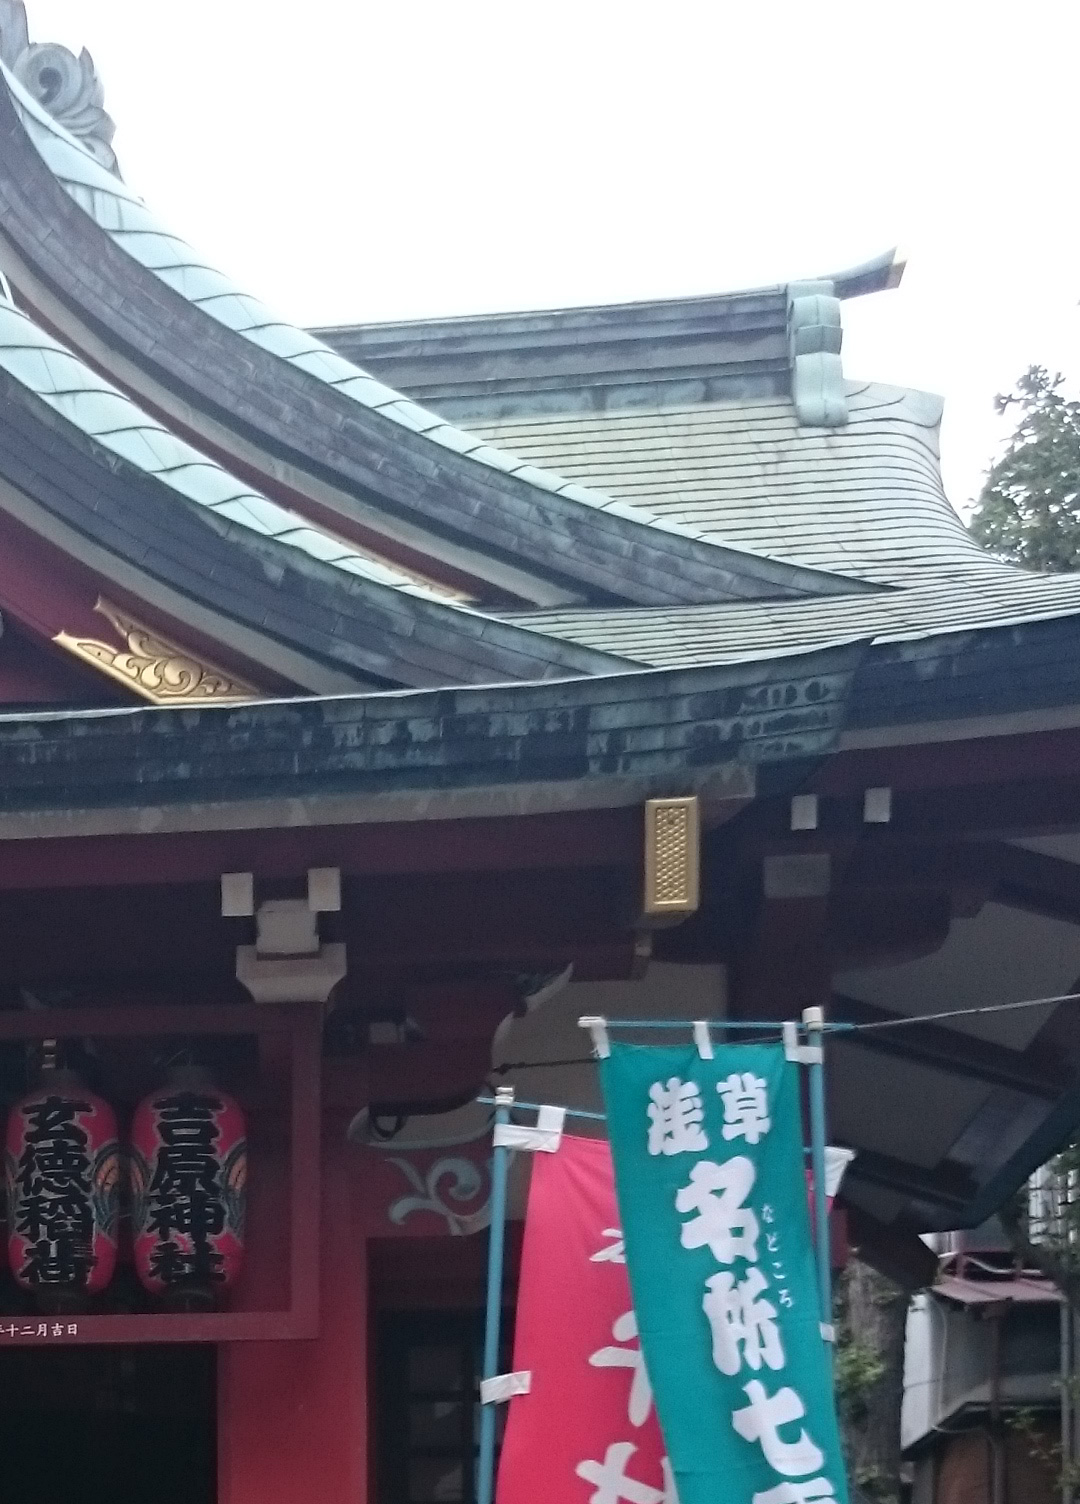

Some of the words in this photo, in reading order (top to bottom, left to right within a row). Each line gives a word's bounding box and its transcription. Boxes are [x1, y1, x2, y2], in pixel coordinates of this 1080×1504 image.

[647, 1072, 771, 1156] 浅草
[150, 1091, 228, 1284] 吉原神社
